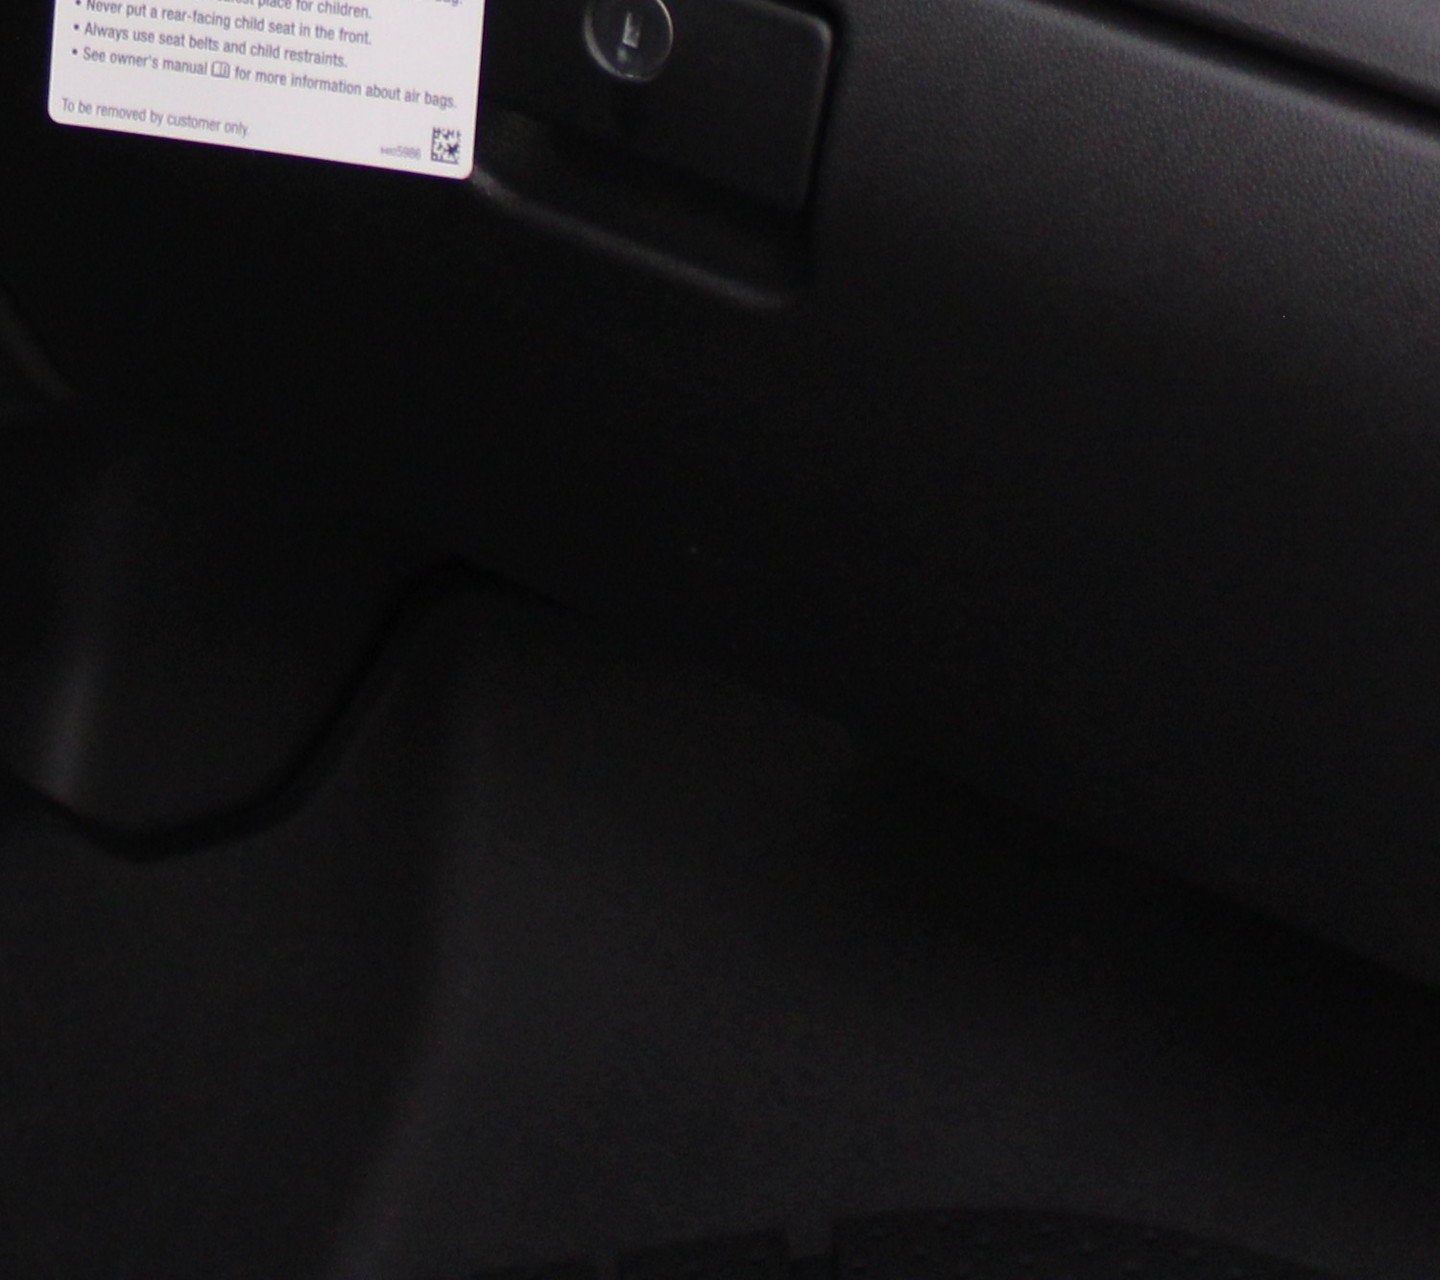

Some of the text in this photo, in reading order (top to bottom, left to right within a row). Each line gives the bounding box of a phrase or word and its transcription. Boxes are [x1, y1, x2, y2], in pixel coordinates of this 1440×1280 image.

[125, 3, 146, 18] put
[149, 6, 158, 18] a
[160, 7, 231, 30] rear-facing
[234, 15, 265, 31] child
[267, 20, 295, 35] seat
[298, 22, 310, 37] in
[314, 24, 334, 40] the
[338, 26, 370, 44] front.
[316, 0, 370, 18] children.
[83, 20, 346, 67] Always use seat belts and child restraints.
[82, 45, 455, 109] See owner's manual for more information about air bags.
